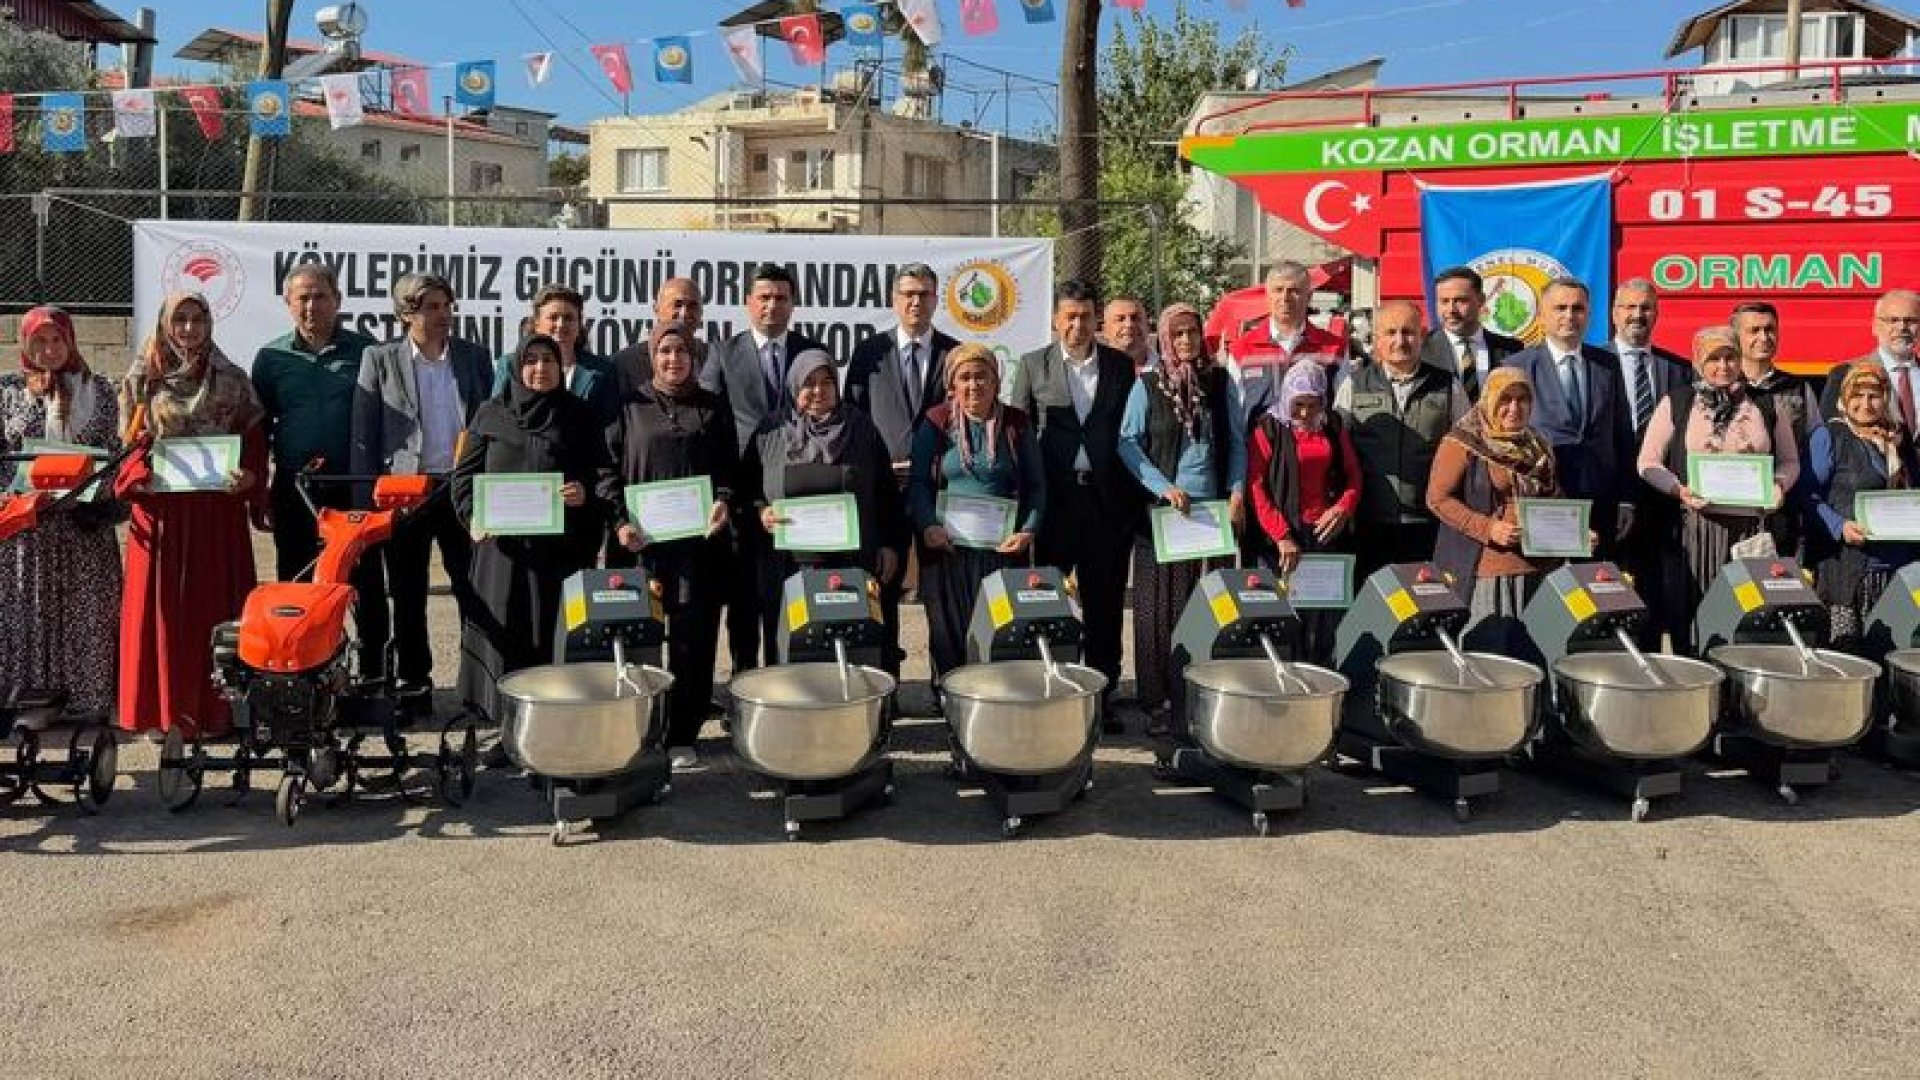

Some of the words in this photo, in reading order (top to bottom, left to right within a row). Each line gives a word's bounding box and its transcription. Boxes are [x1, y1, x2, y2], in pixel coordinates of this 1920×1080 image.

[1321, 134, 1454, 166] KOZAN
[1467, 127, 1621, 160] ORMAN
[1661, 117, 1858, 155] İŞLETME
[1649, 188, 1717, 220] 01
[1744, 184, 1893, 218] S-45
[1652, 251, 1883, 291] ORMAN
